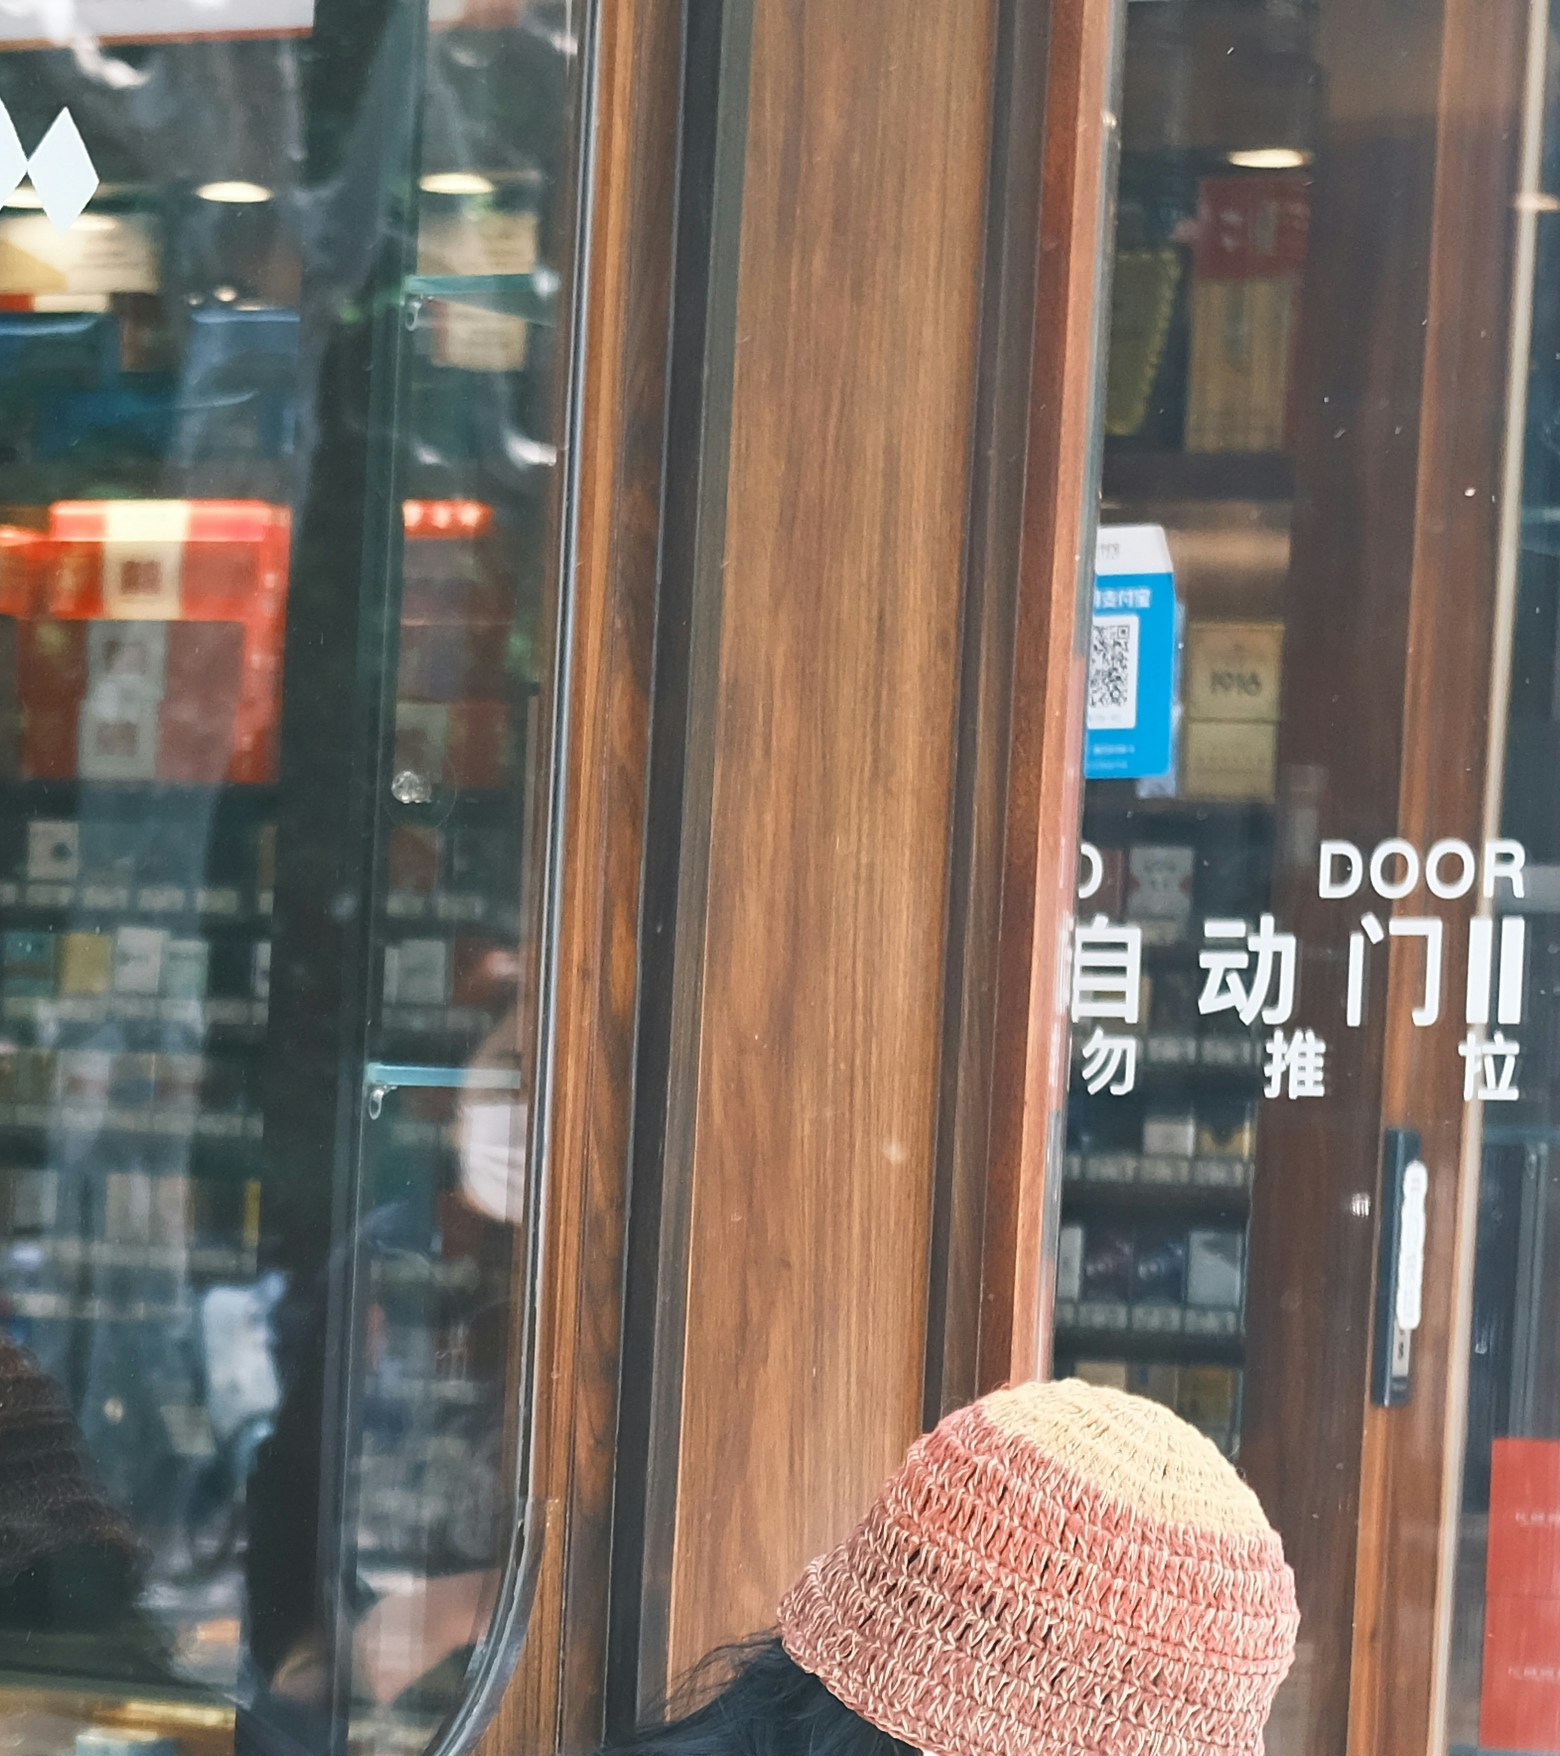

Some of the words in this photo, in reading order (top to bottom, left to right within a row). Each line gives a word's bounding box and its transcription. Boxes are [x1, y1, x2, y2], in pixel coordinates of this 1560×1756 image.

[1317, 840, 1526, 900] DOOR
[1071, 912, 1442, 1028] 自动门
[1081, 1028, 1520, 1102] 勿推拉
